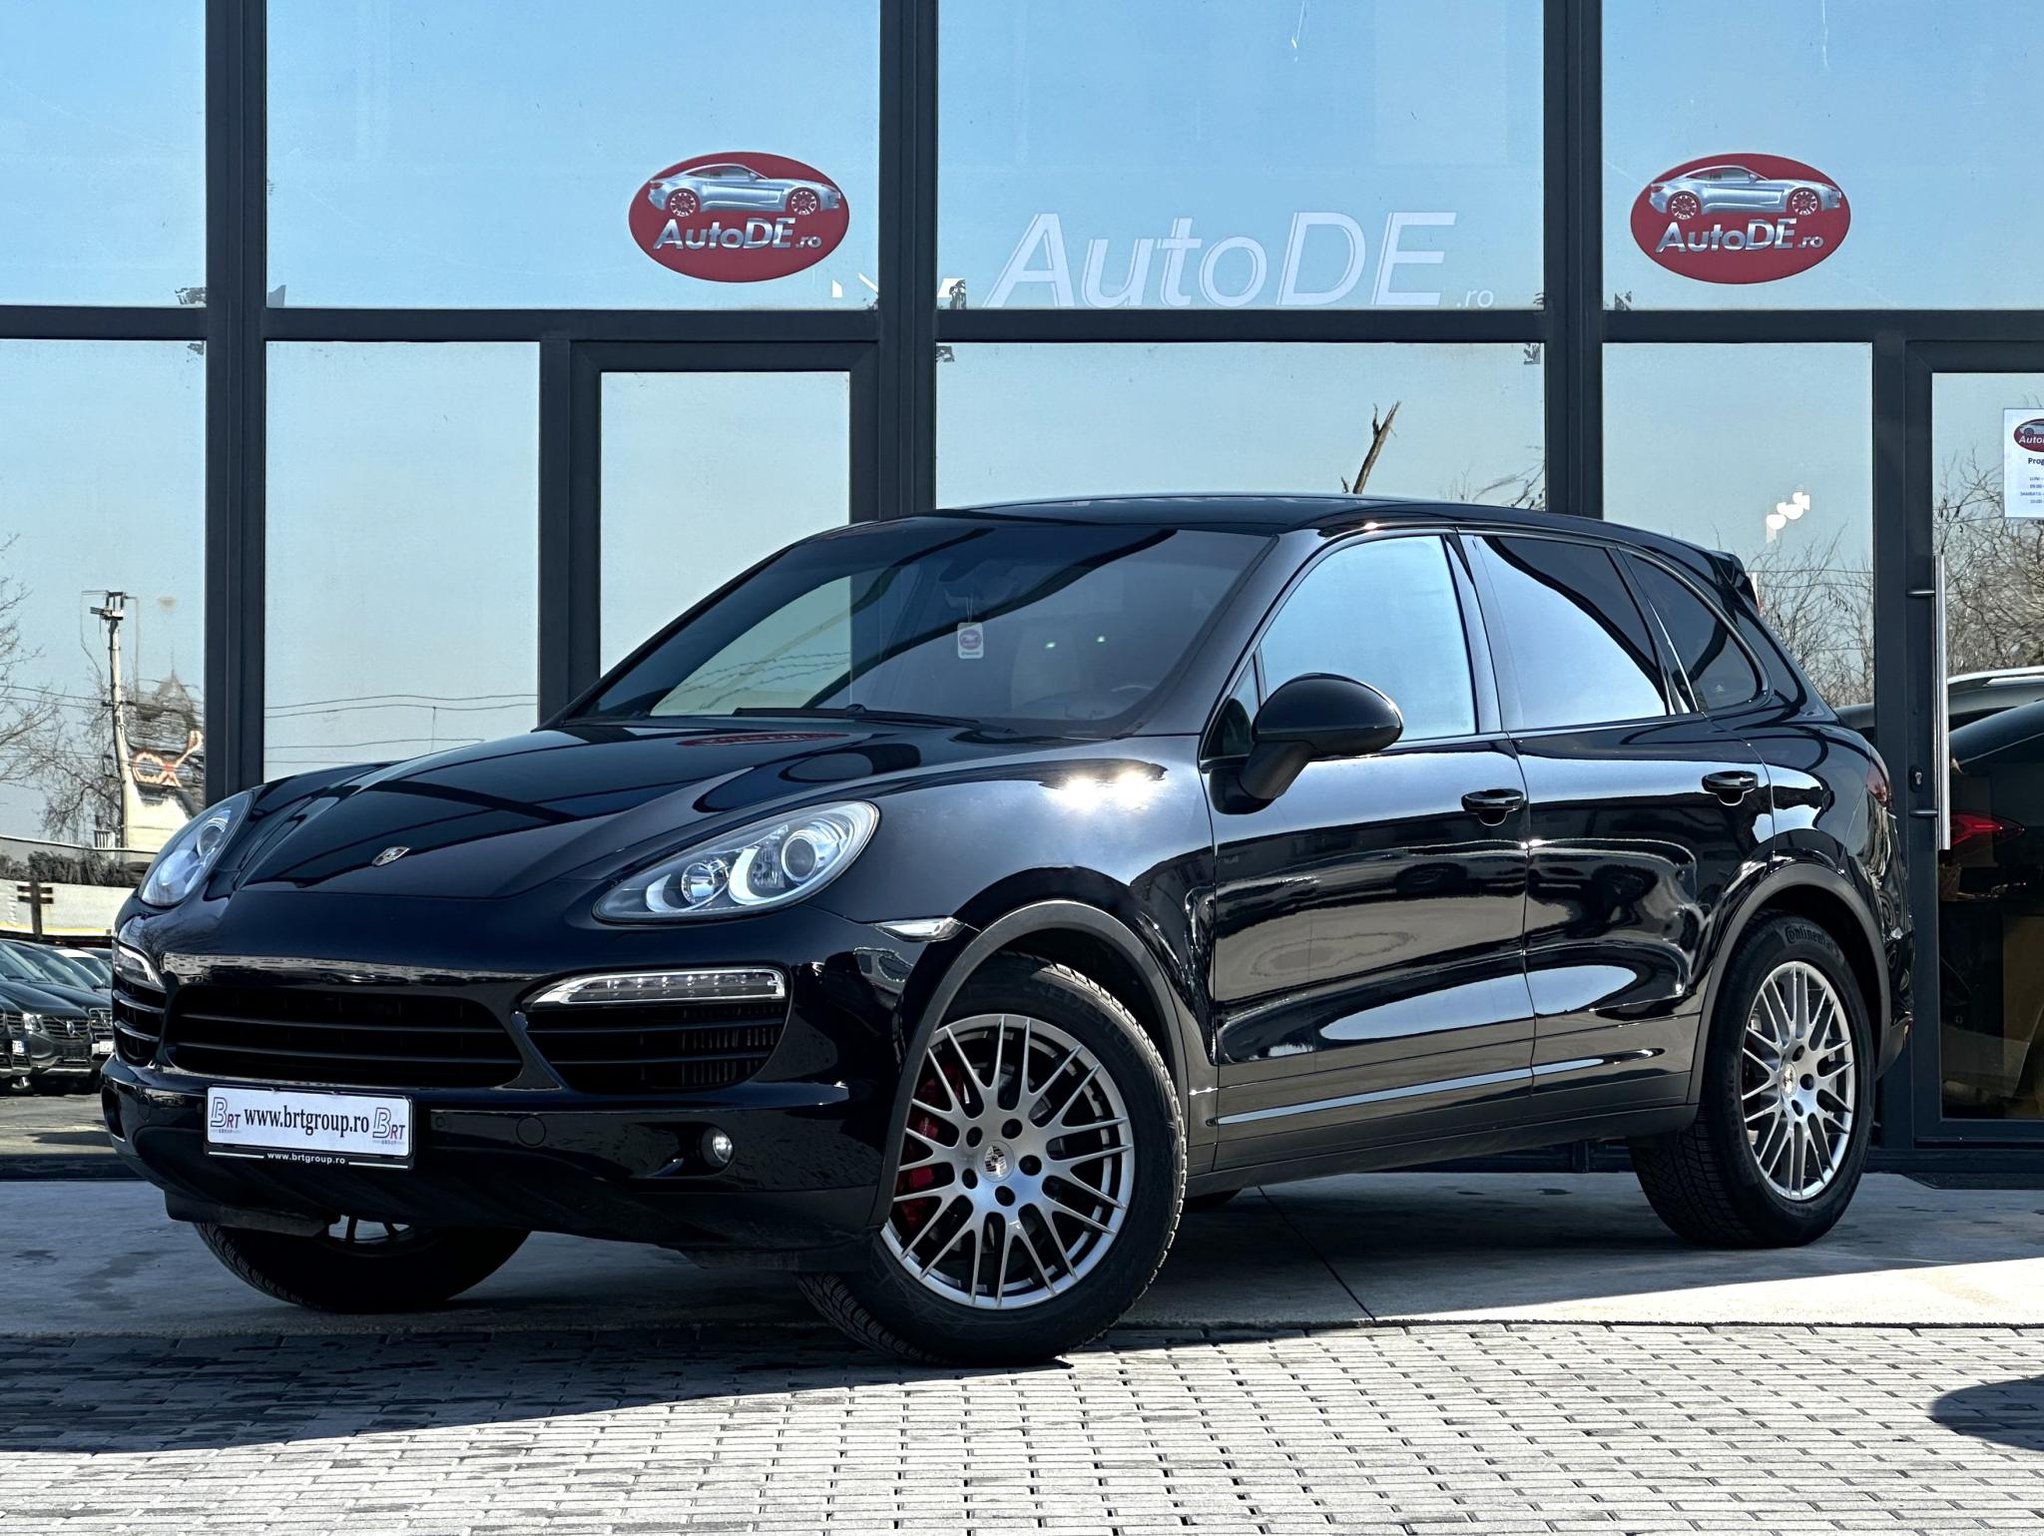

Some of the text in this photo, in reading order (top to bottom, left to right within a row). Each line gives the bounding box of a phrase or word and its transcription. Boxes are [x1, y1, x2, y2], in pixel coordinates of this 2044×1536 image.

[2018, 435, 2044, 444] Auto
[244, 1105, 369, 1138] www.brtgroup.ro
[267, 1152, 346, 1165] www.brtgroup.ro
